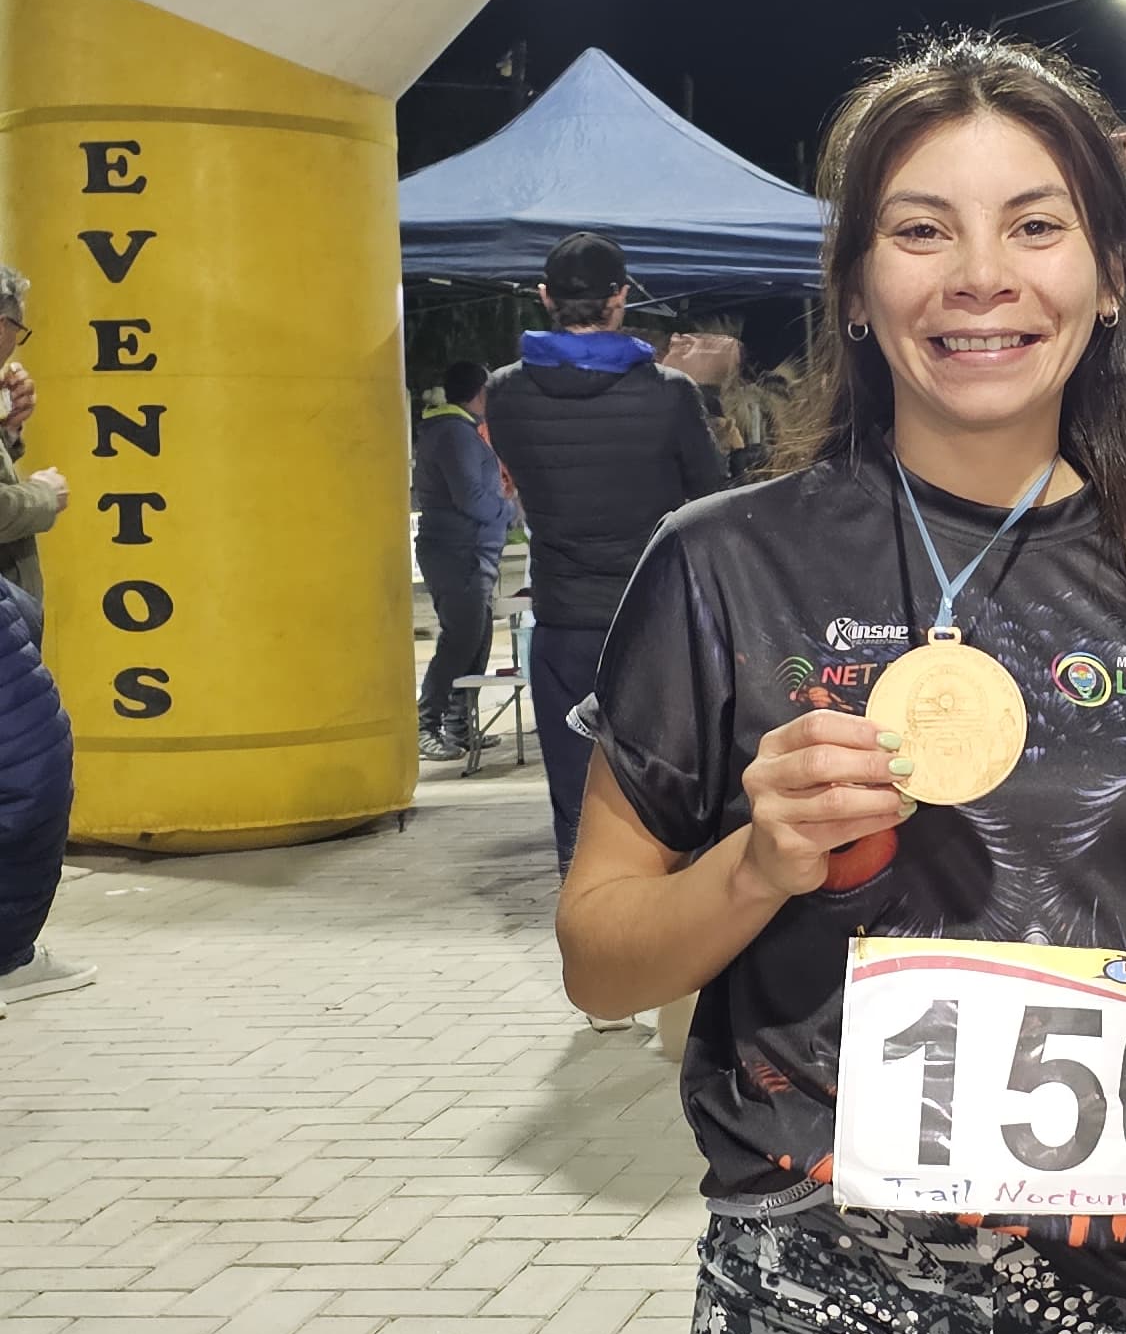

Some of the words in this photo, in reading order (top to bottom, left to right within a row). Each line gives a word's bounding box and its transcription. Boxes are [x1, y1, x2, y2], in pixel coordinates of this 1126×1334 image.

[77, 140, 174, 719] EVENTOS
[821, 663, 878, 686] NET
[883, 1177, 972, 1204] Trail
